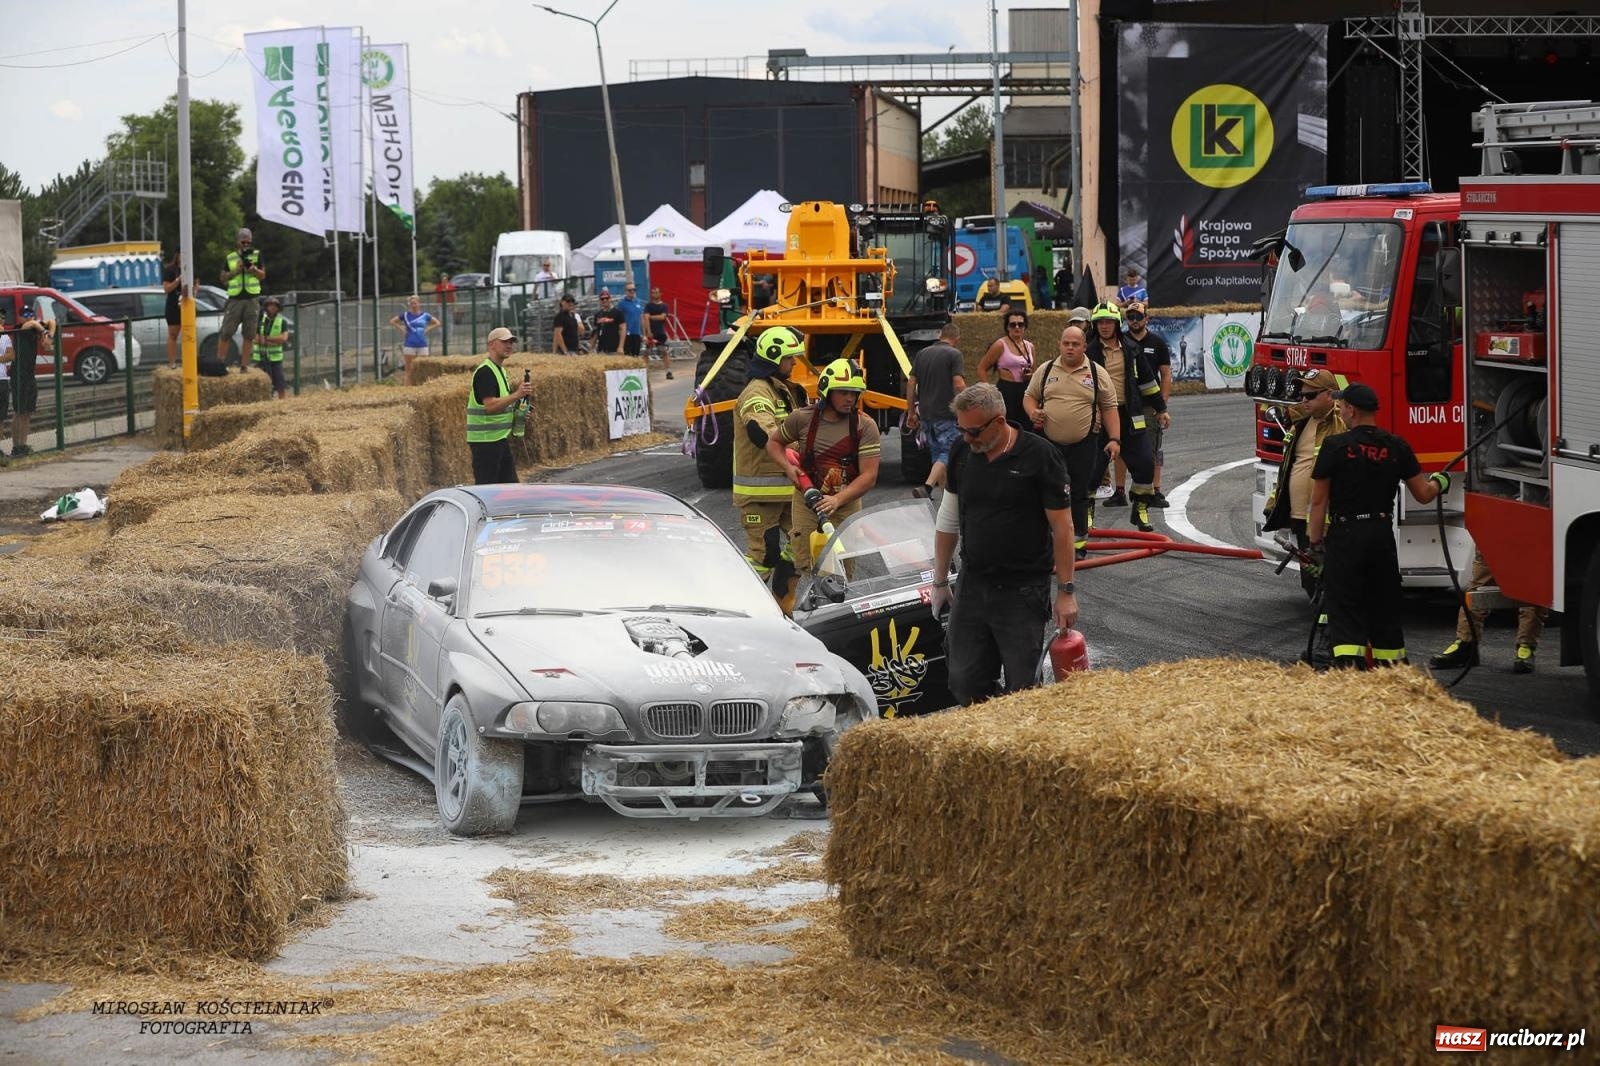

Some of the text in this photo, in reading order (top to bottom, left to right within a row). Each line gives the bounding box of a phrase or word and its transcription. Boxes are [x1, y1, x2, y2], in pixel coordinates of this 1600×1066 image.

[1199, 219, 1252, 234] Krajowa
[1199, 233, 1241, 247] Grupa
[1186, 275, 1213, 288] Grupa
[1408, 405, 1447, 424] NOWA
[1346, 443, 1389, 463] STRA
